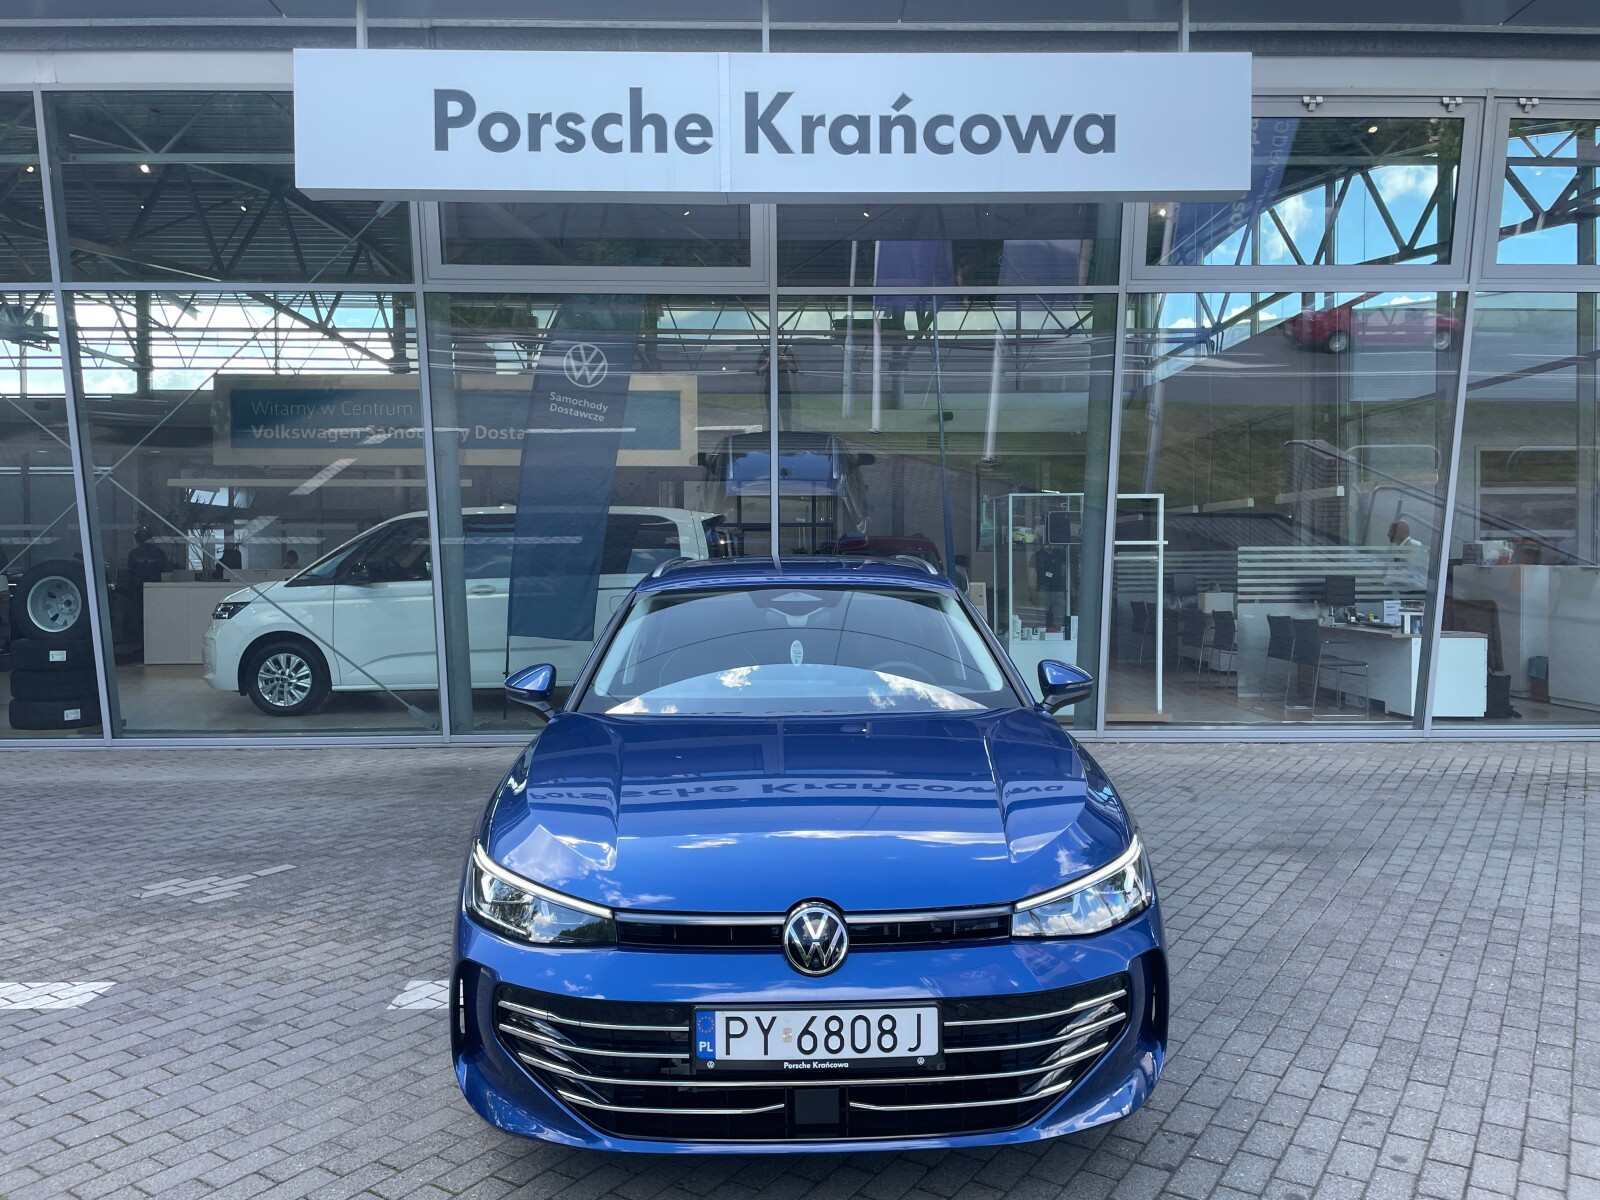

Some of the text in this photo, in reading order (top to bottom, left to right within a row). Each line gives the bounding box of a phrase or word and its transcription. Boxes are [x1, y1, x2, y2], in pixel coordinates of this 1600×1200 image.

[434, 87, 1117, 155] Porsche Krańcowa
[252, 401, 413, 419] Witamy w Centrum
[550, 392, 608, 413] Samochody
[550, 403, 605, 421] Dostawcze
[251, 424, 361, 442] Volkswagen
[725, 1013, 922, 1056] PY 6808J
[699, 1041, 713, 1052] PL
[783, 1060, 849, 1069] Porsche Krańcowa
